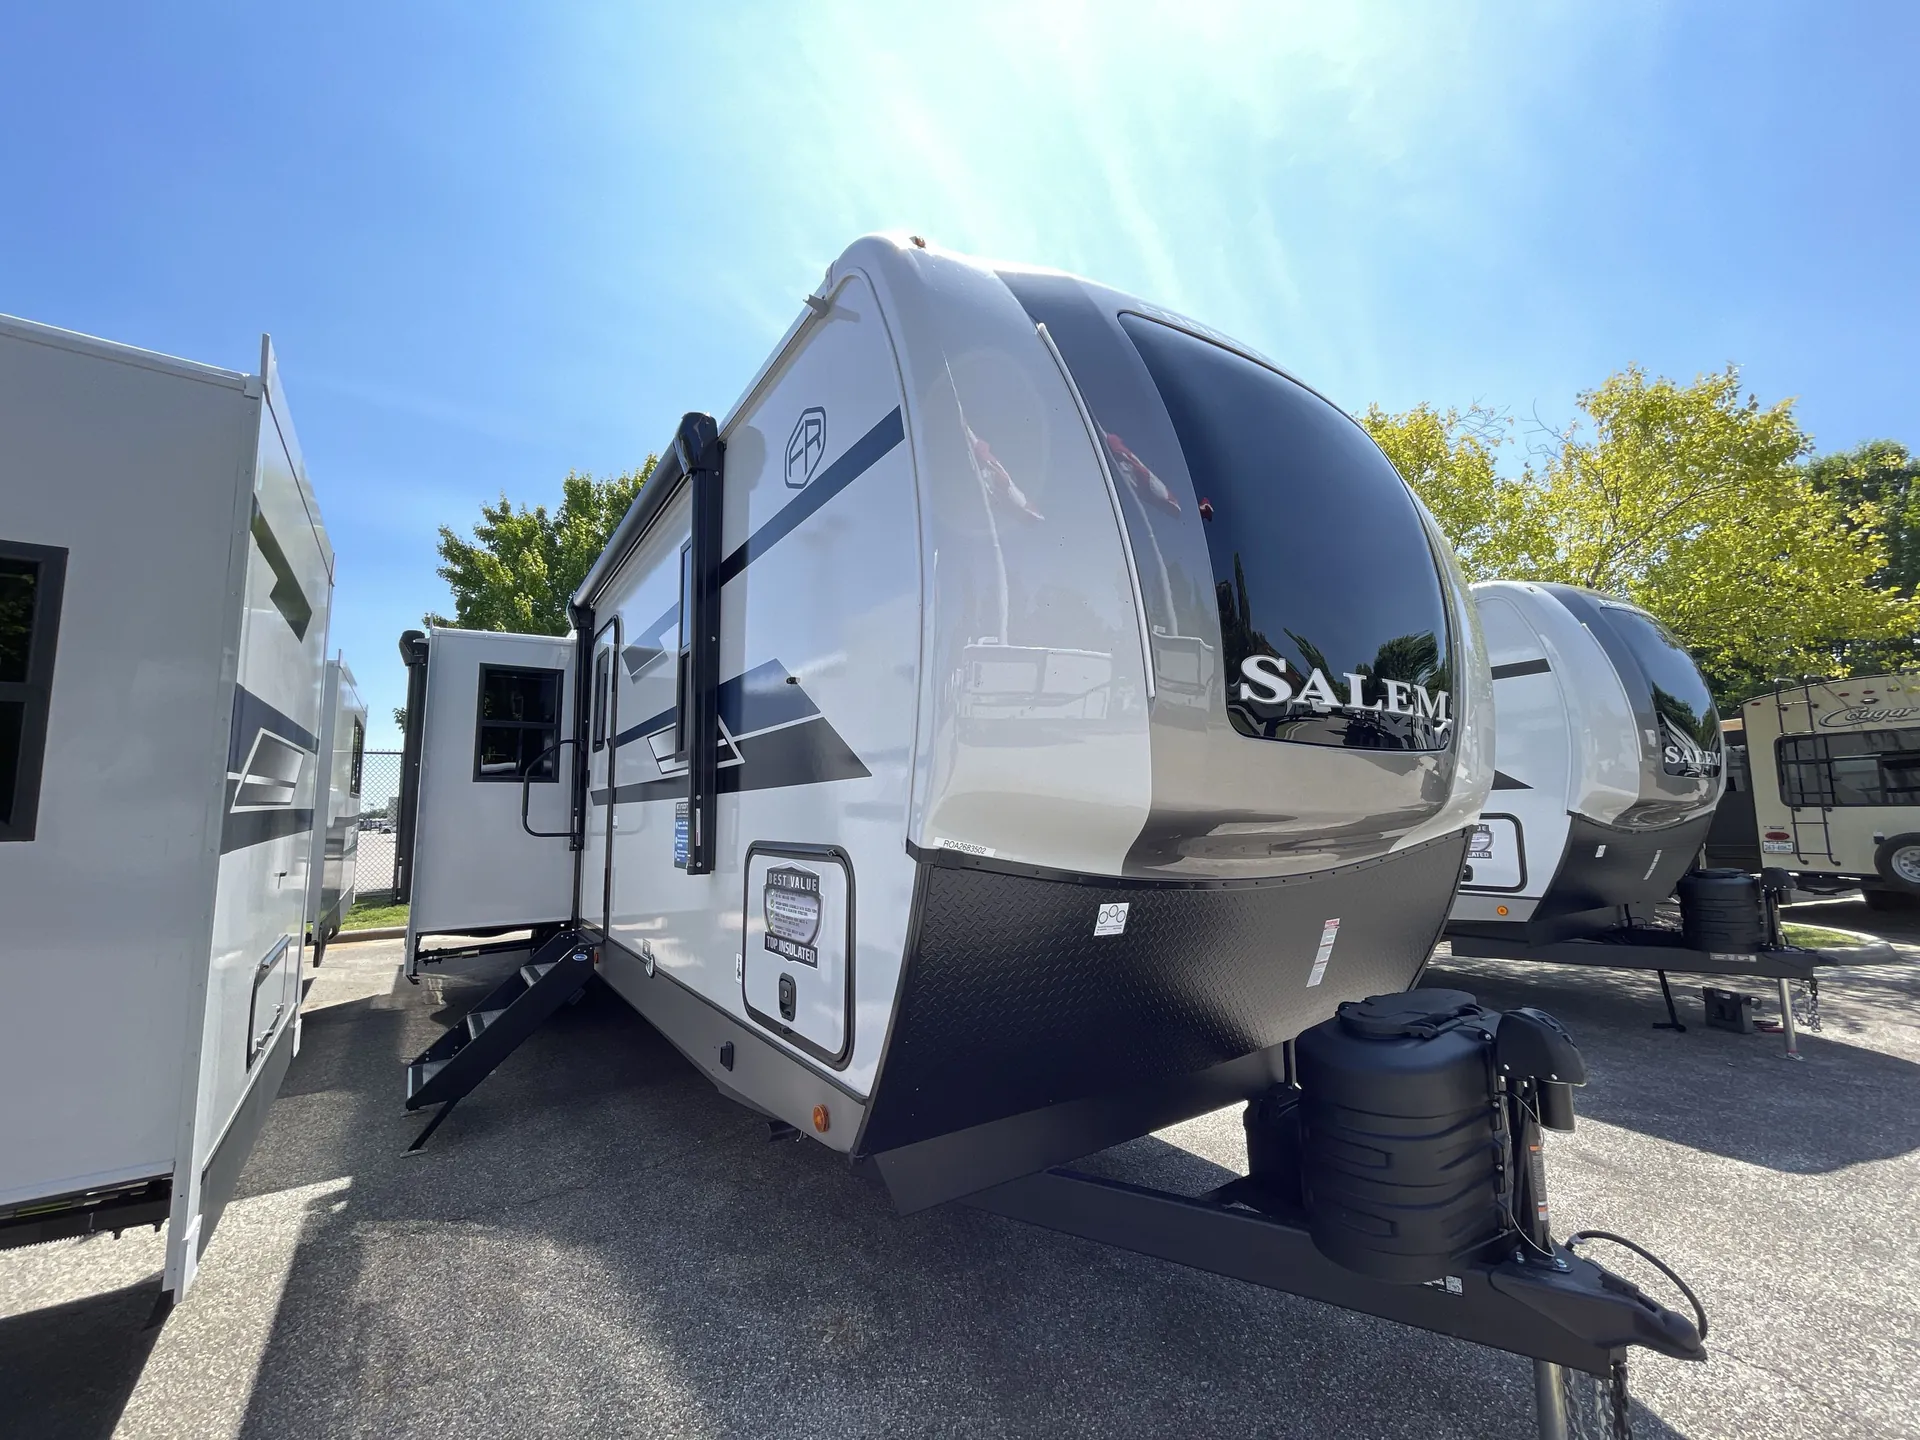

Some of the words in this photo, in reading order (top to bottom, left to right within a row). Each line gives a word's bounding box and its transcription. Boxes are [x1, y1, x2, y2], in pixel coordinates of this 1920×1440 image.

[1239, 654, 1453, 722] SALEM
[1818, 705, 1919, 728] Cougar
[1664, 745, 1721, 766] SALEM
[942, 839, 987, 855] ROA2683502
[790, 875, 817, 892] VALUE
[766, 935, 778, 950] TOP
[778, 939, 815, 963] INSULATED
